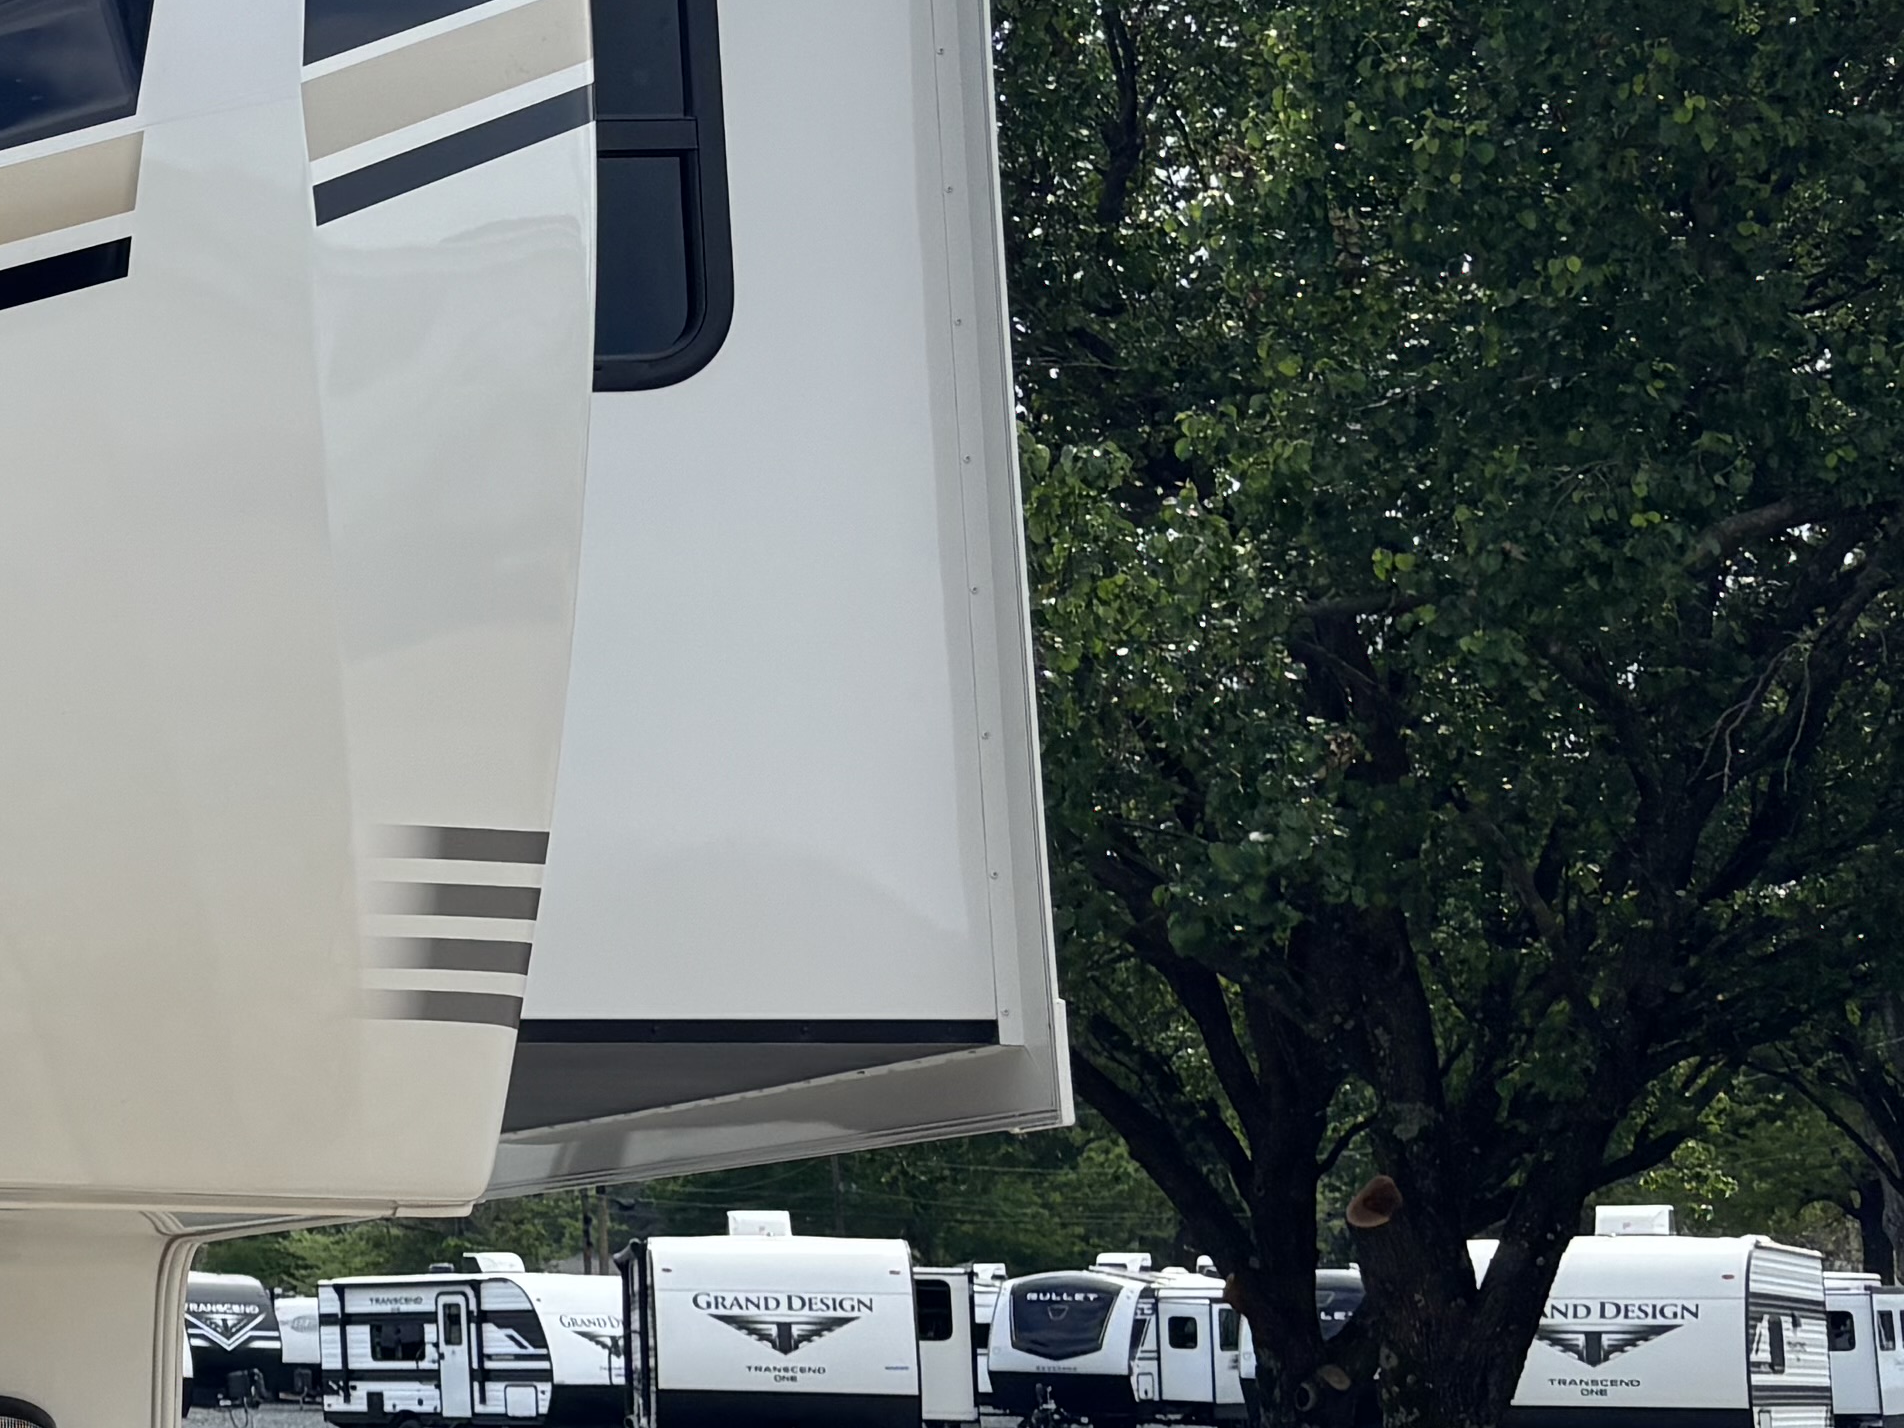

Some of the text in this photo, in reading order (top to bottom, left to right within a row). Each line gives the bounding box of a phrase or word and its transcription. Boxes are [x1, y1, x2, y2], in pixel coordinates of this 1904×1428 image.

[692, 1292, 874, 1313] GRAND DESIGN
[1599, 1301, 1700, 1320] DESIGN
[745, 1365, 827, 1375] TRANSCEND
[1548, 1378, 1641, 1387] TRANSCEND
[1580, 1387, 1608, 1396] ONE
